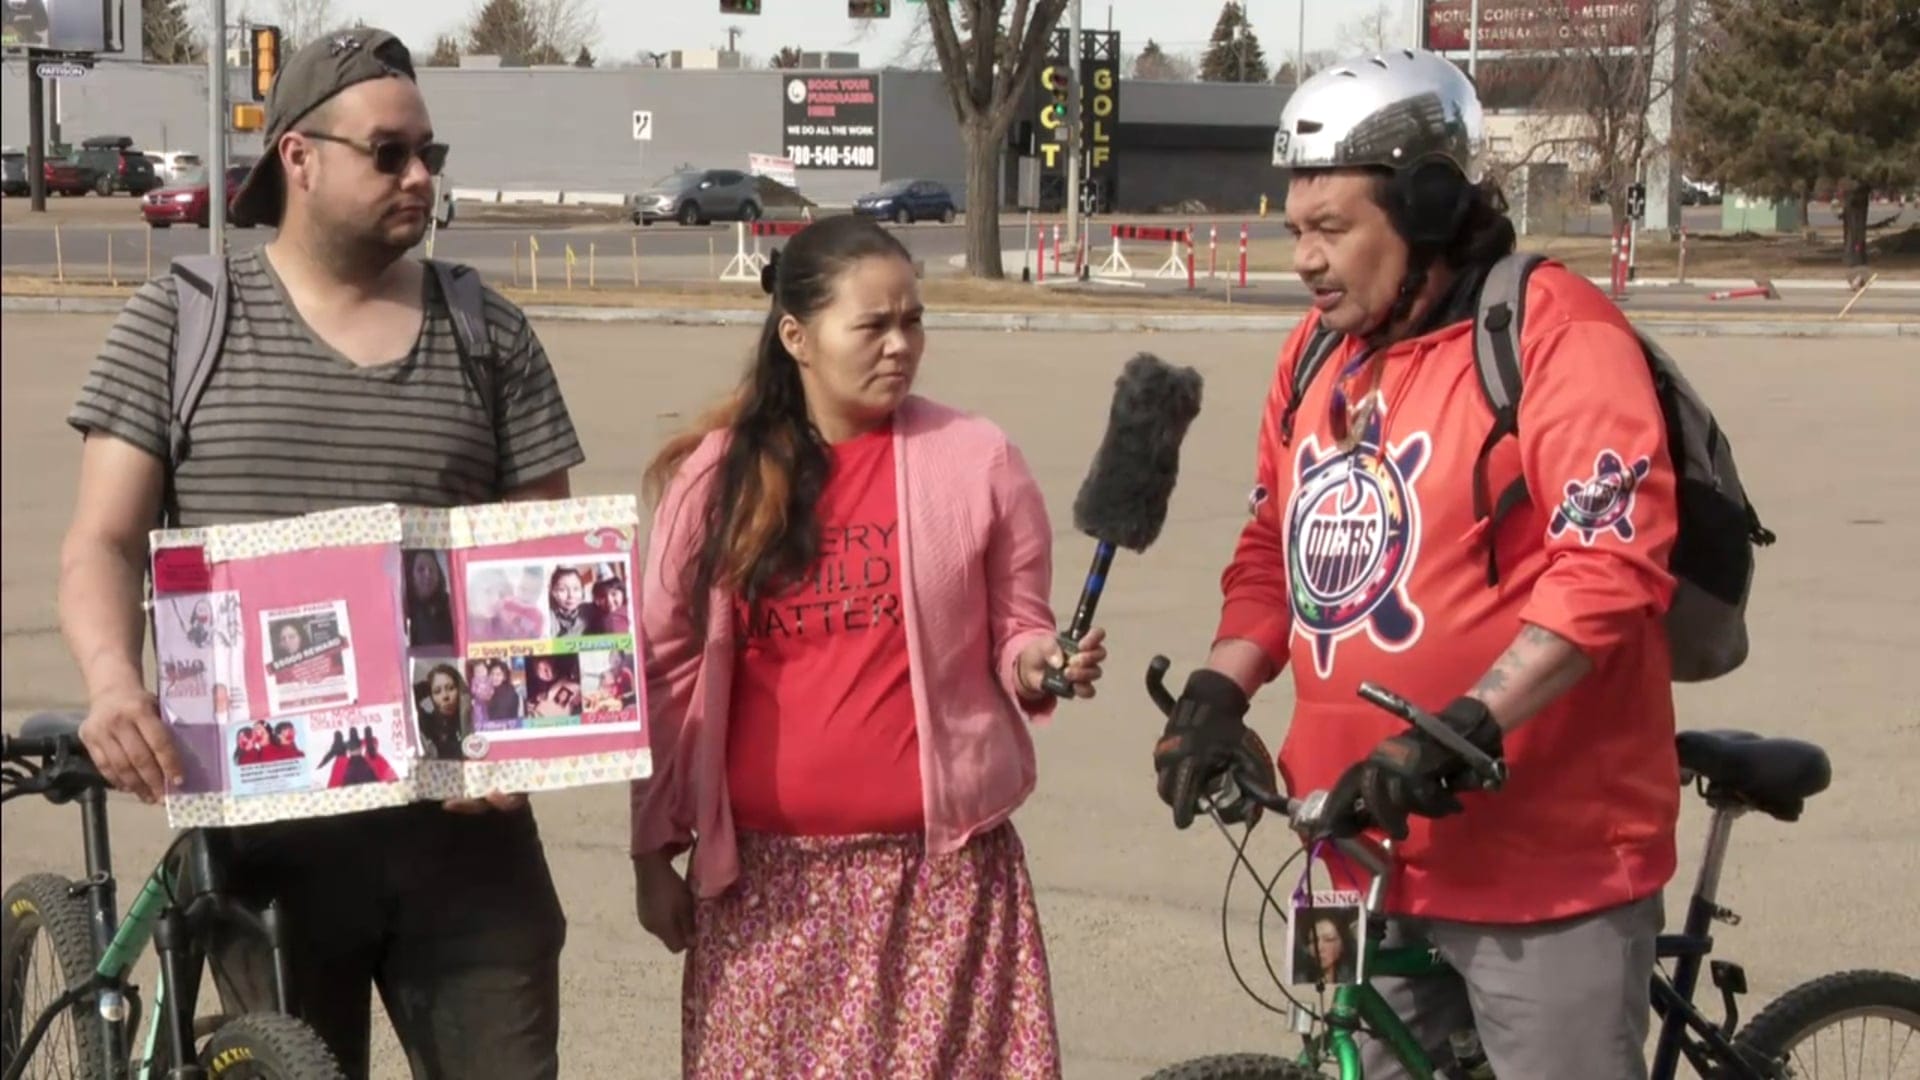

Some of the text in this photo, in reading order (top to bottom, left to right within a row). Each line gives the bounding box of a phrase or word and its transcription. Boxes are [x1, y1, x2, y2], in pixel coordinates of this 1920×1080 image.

[807, 79, 870, 90] BOOK YOUR
[807, 92, 875, 104] FUNDRAISER
[1093, 69, 1112, 168] GOLF
[787, 125, 874, 135] WE DO ALL THE WORK
[787, 145, 874, 166] 780-540-5400
[820, 521, 898, 558] ERY
[814, 555, 892, 594] ILD
